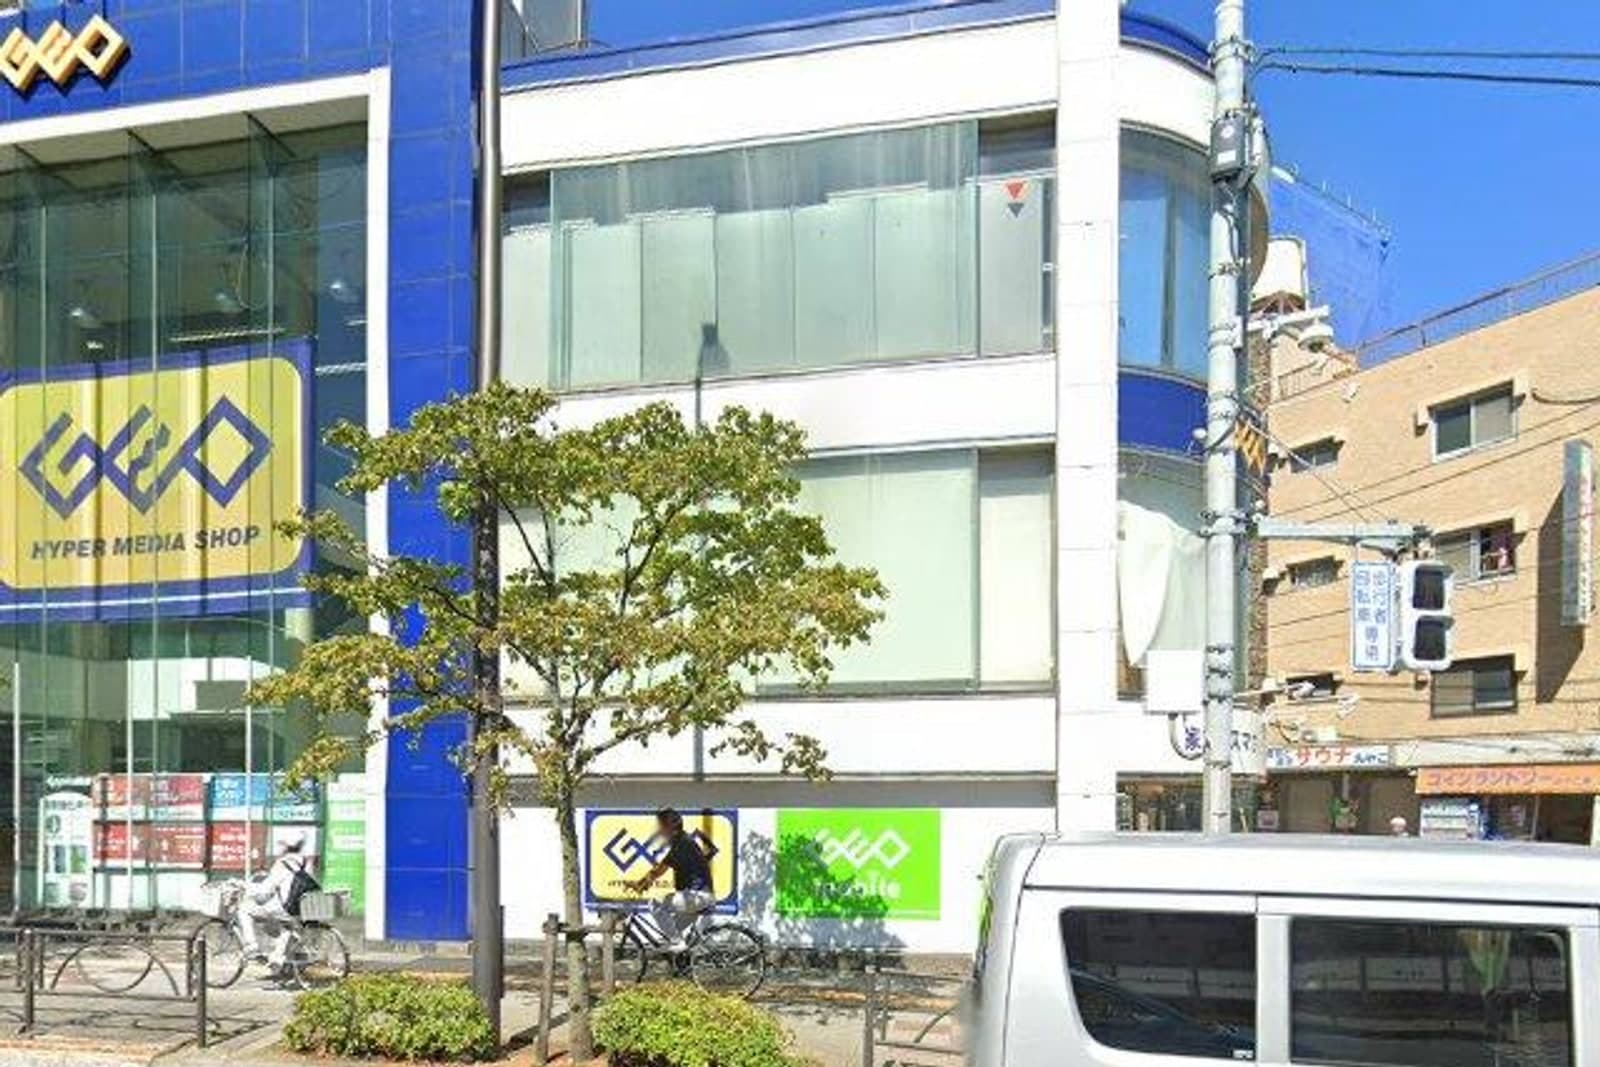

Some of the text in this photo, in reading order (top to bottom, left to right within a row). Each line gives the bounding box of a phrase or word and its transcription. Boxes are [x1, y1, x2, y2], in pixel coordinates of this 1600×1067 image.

[0, 13, 127, 90] GEO
[19, 394, 274, 520] GEO
[31, 525, 261, 560] HYPER MEDIA SHOP
[1296, 743, 1351, 765] サウナ
